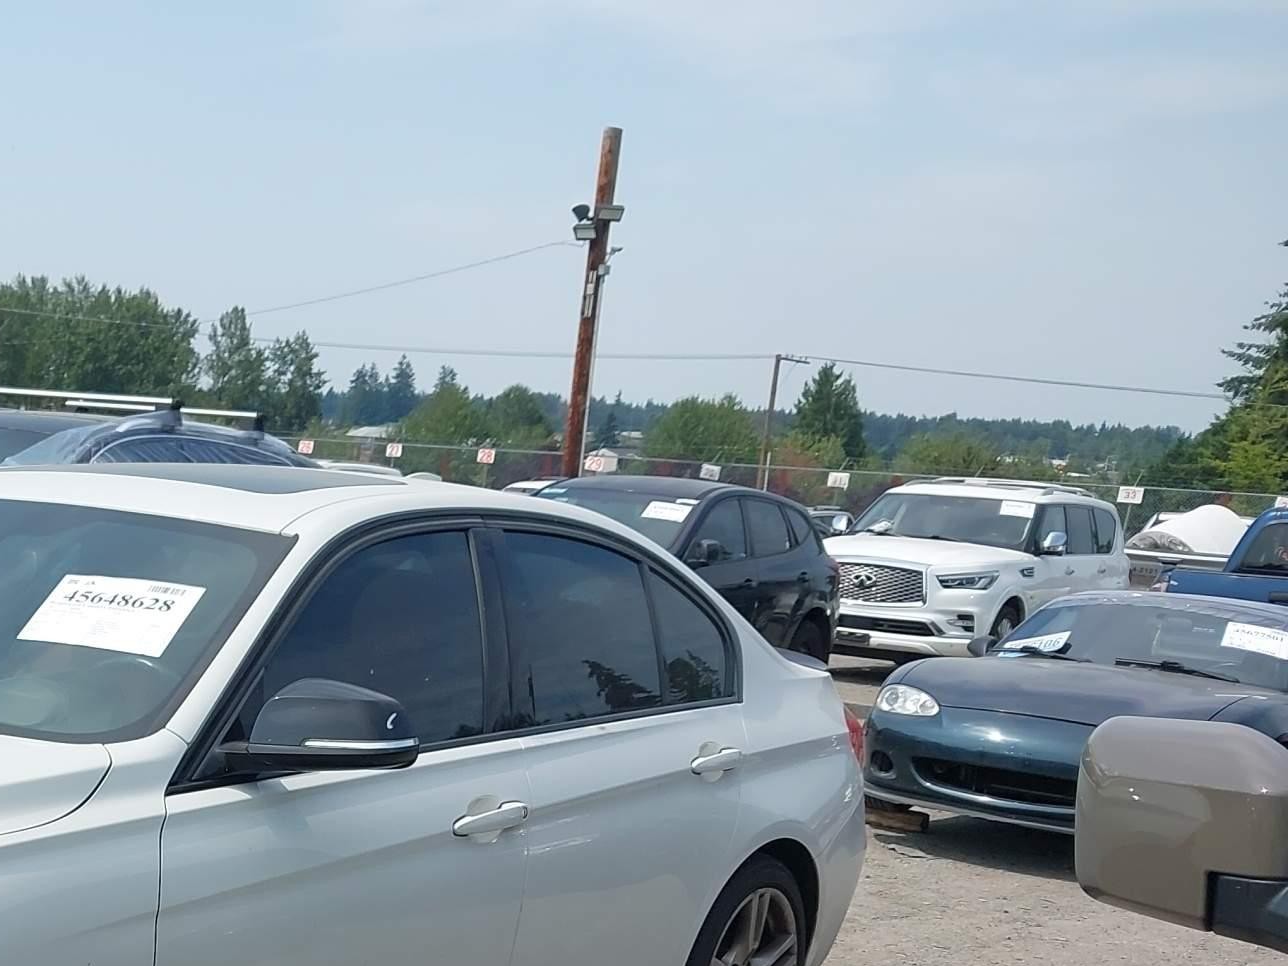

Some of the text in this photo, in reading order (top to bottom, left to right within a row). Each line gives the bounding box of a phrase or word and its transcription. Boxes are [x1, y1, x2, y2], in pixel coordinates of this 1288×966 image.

[479, 450, 492, 462] 28
[586, 457, 601, 470] 29
[64, 590, 175, 612] 45648628
